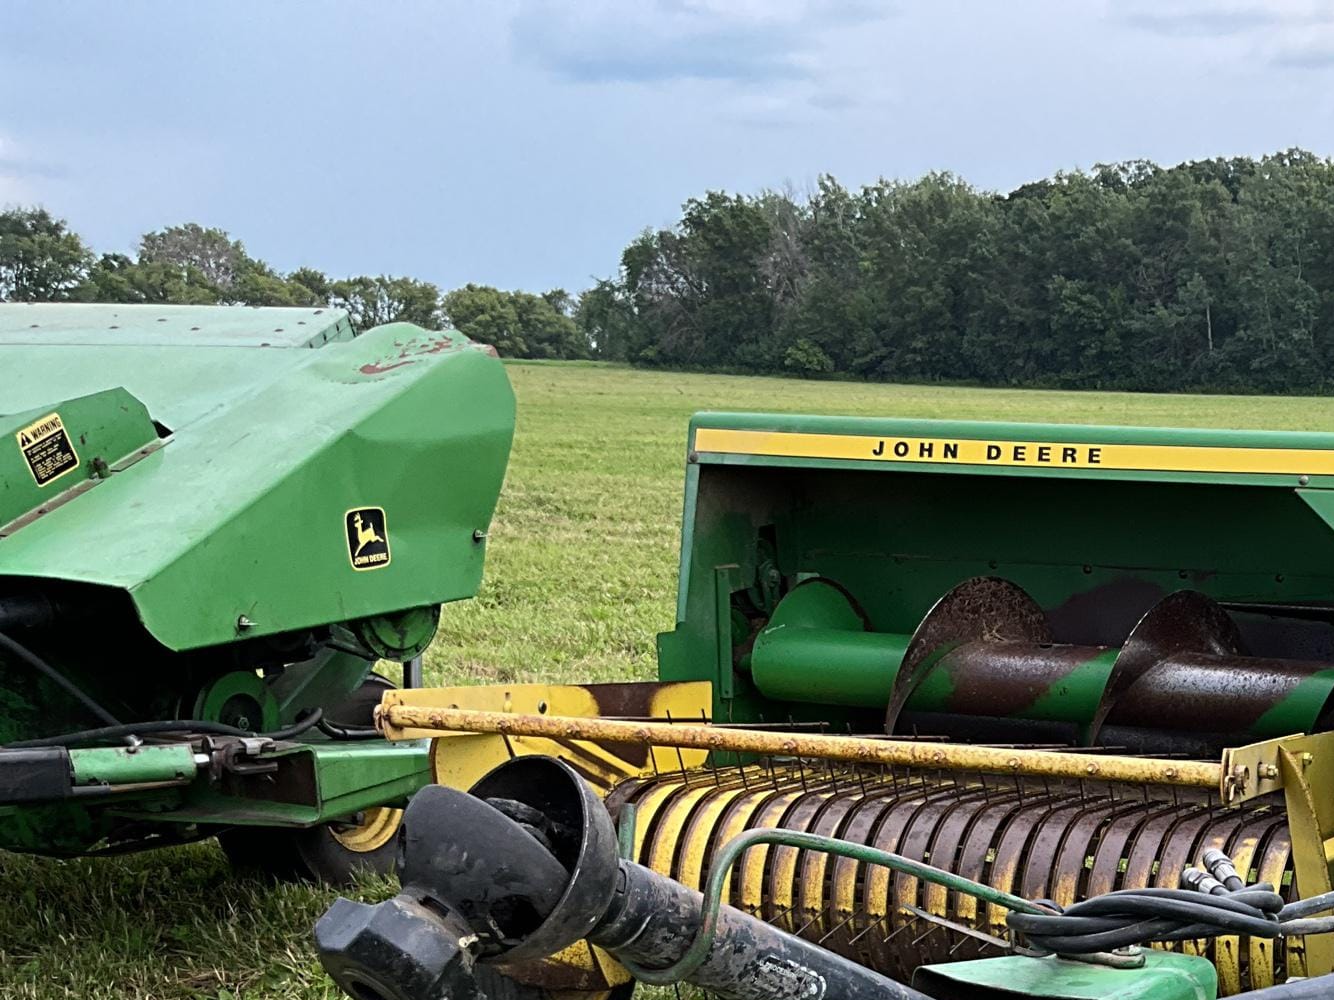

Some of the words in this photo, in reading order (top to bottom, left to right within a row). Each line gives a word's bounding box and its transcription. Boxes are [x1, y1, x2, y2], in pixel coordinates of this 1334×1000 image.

[31, 417, 61, 440] WARNING
[873, 441, 958, 459] JOHN
[987, 445, 1101, 464] DEERE
[369, 552, 388, 562] DEERE
